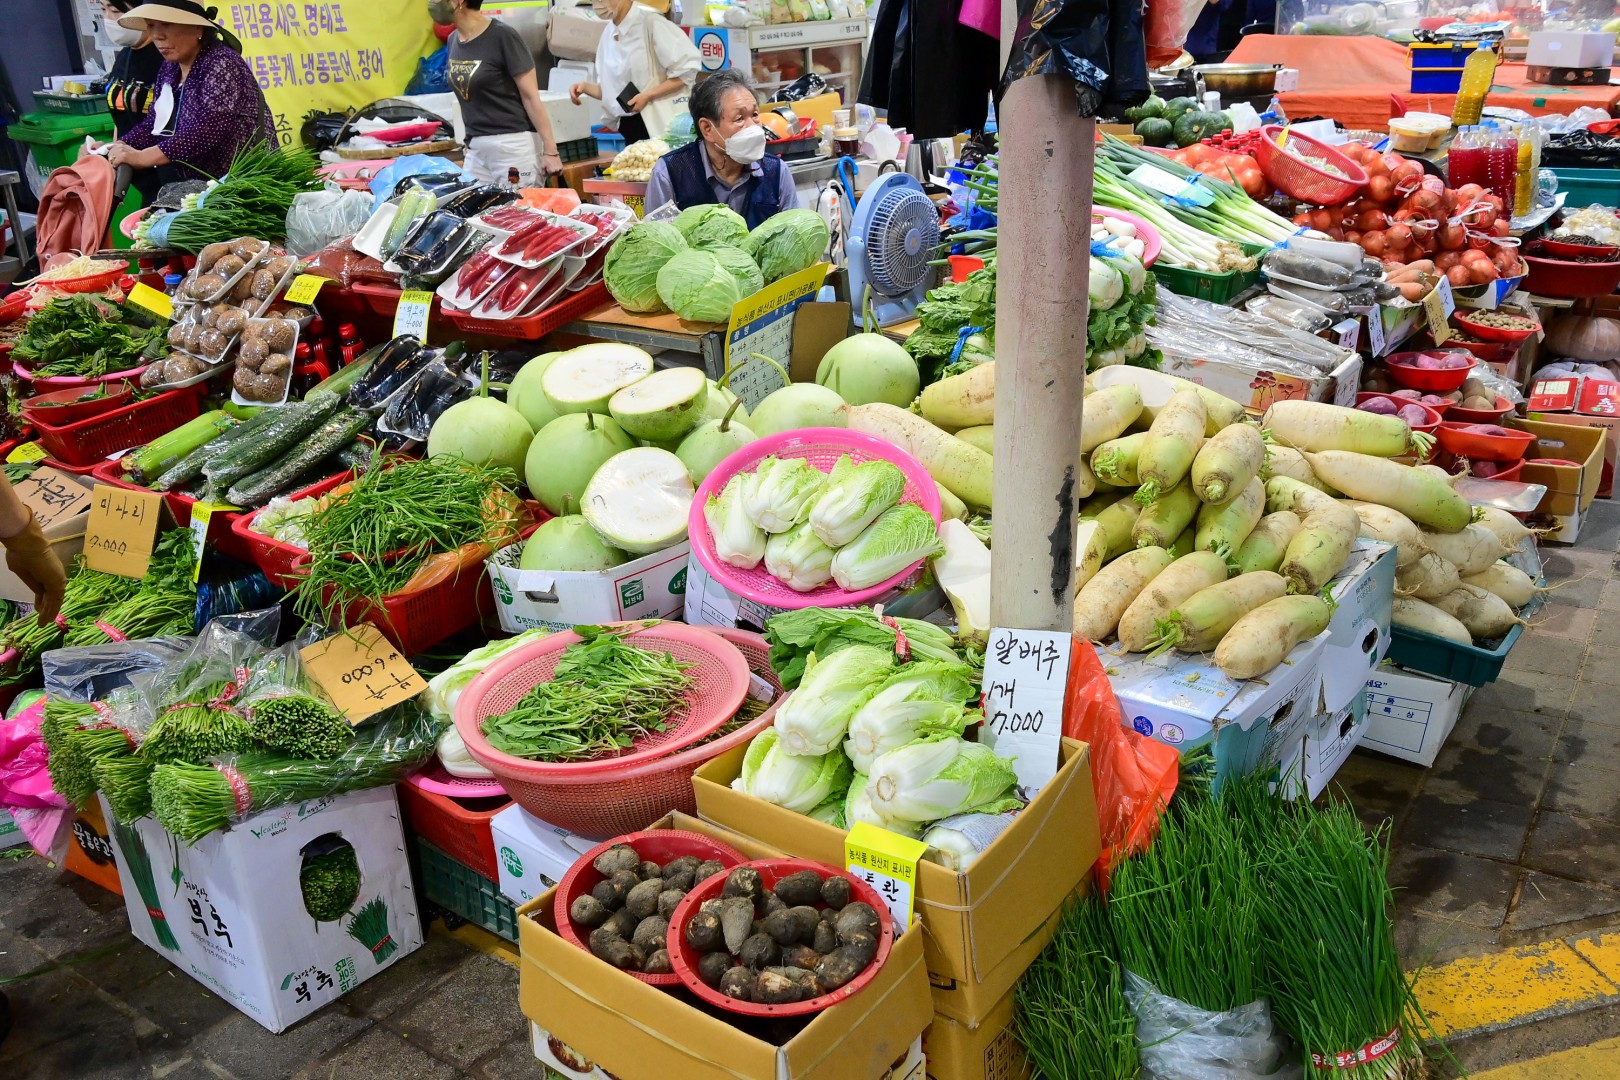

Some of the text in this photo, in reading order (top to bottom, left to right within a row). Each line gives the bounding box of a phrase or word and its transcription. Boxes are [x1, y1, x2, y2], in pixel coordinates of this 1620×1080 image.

[701, 42, 723, 58] 담배
[100, 493, 147, 526] 미나리
[995, 630, 1060, 681] 알배추
[987, 679, 1016, 709] 1개
[989, 710, 1044, 736] 7.000
[250, 816, 288, 839] Healthy
[848, 849, 912, 879] 농식품 원산지 표시판
[187, 898, 233, 949] 부추
[294, 968, 334, 1004] 부추
